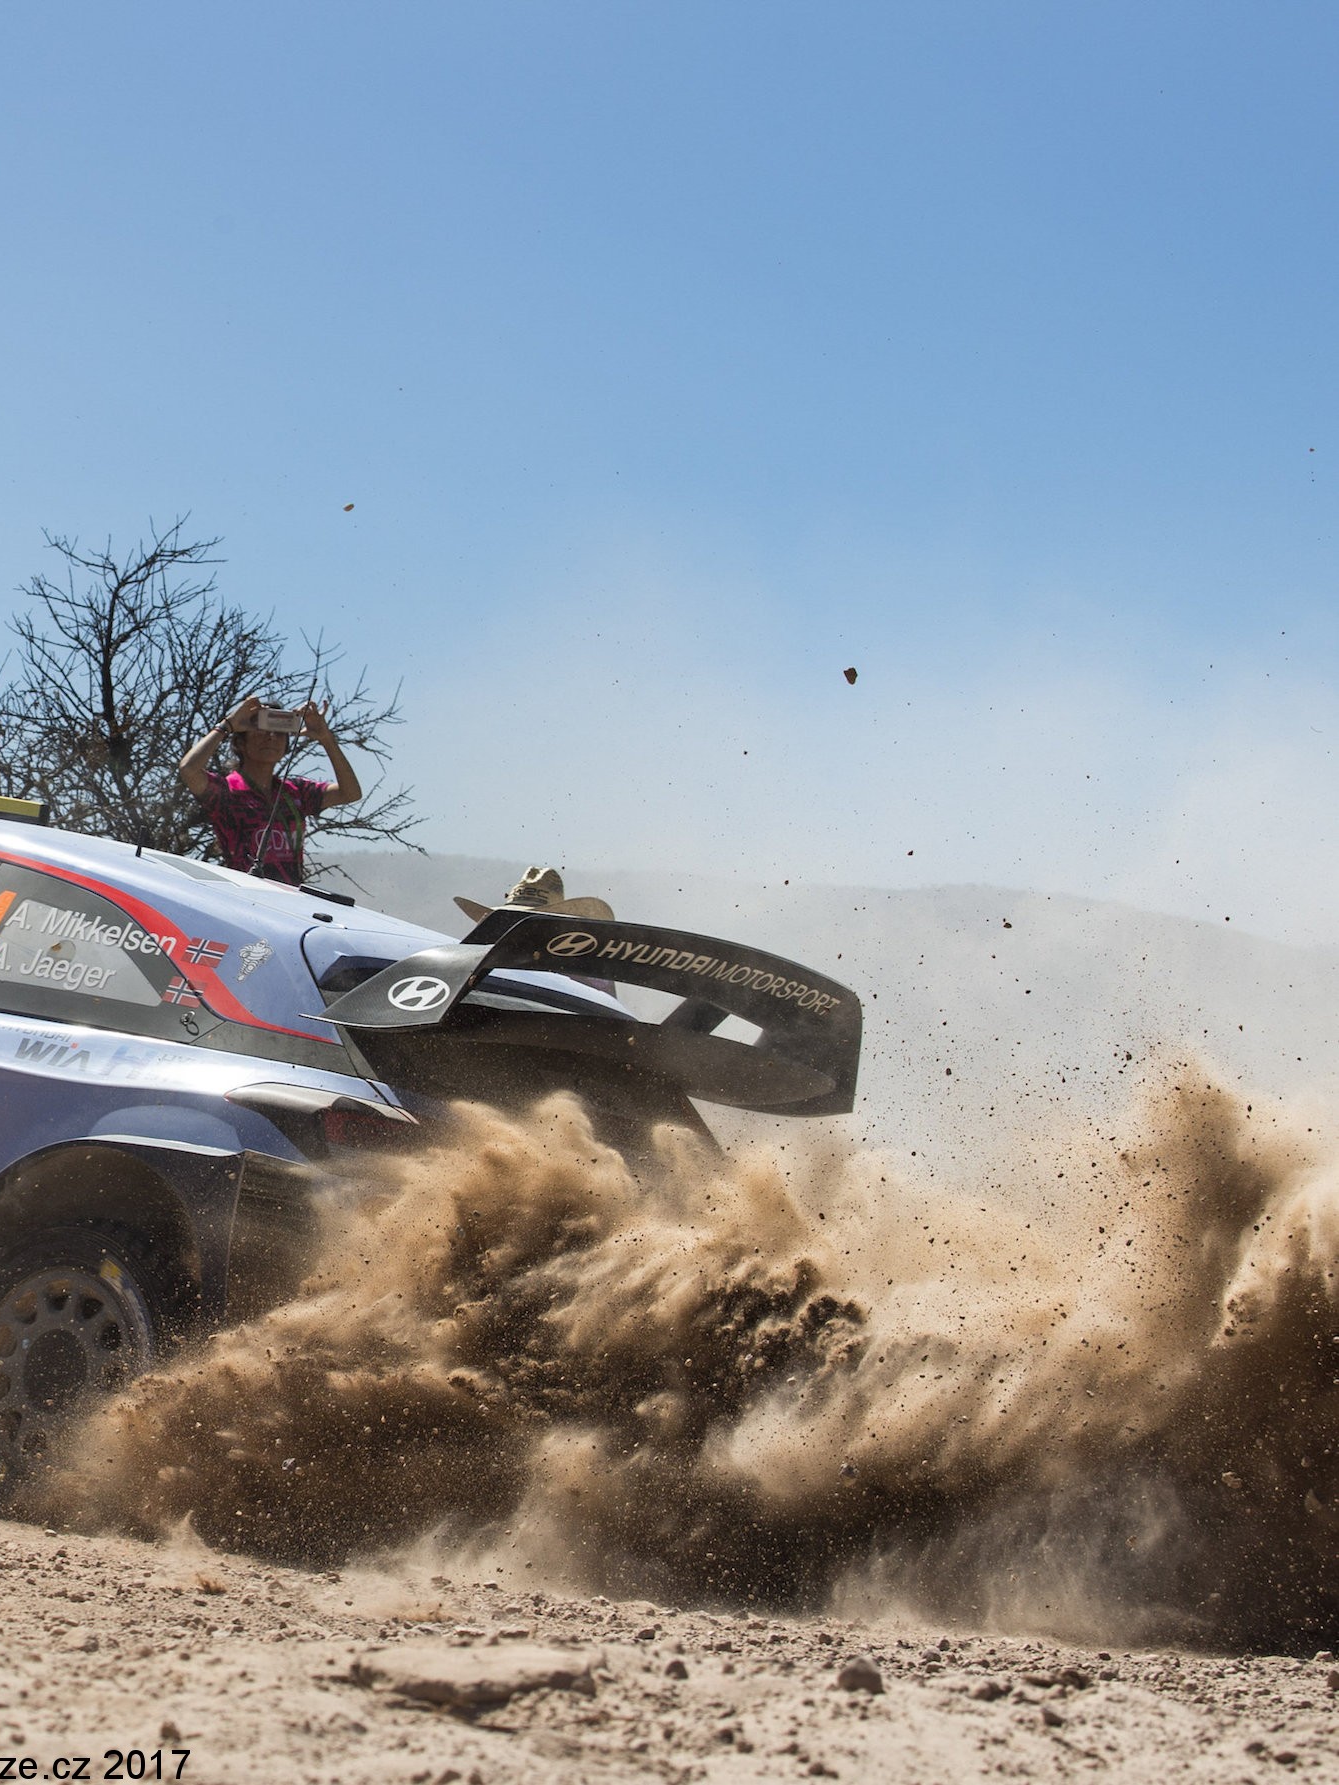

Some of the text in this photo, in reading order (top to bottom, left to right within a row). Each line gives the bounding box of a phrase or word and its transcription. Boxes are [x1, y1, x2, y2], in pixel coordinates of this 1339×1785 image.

[4, 902, 178, 957] A. Mikkelsen
[19, 949, 117, 991] Jaeger
[597, 939, 716, 976] HYUNDAI
